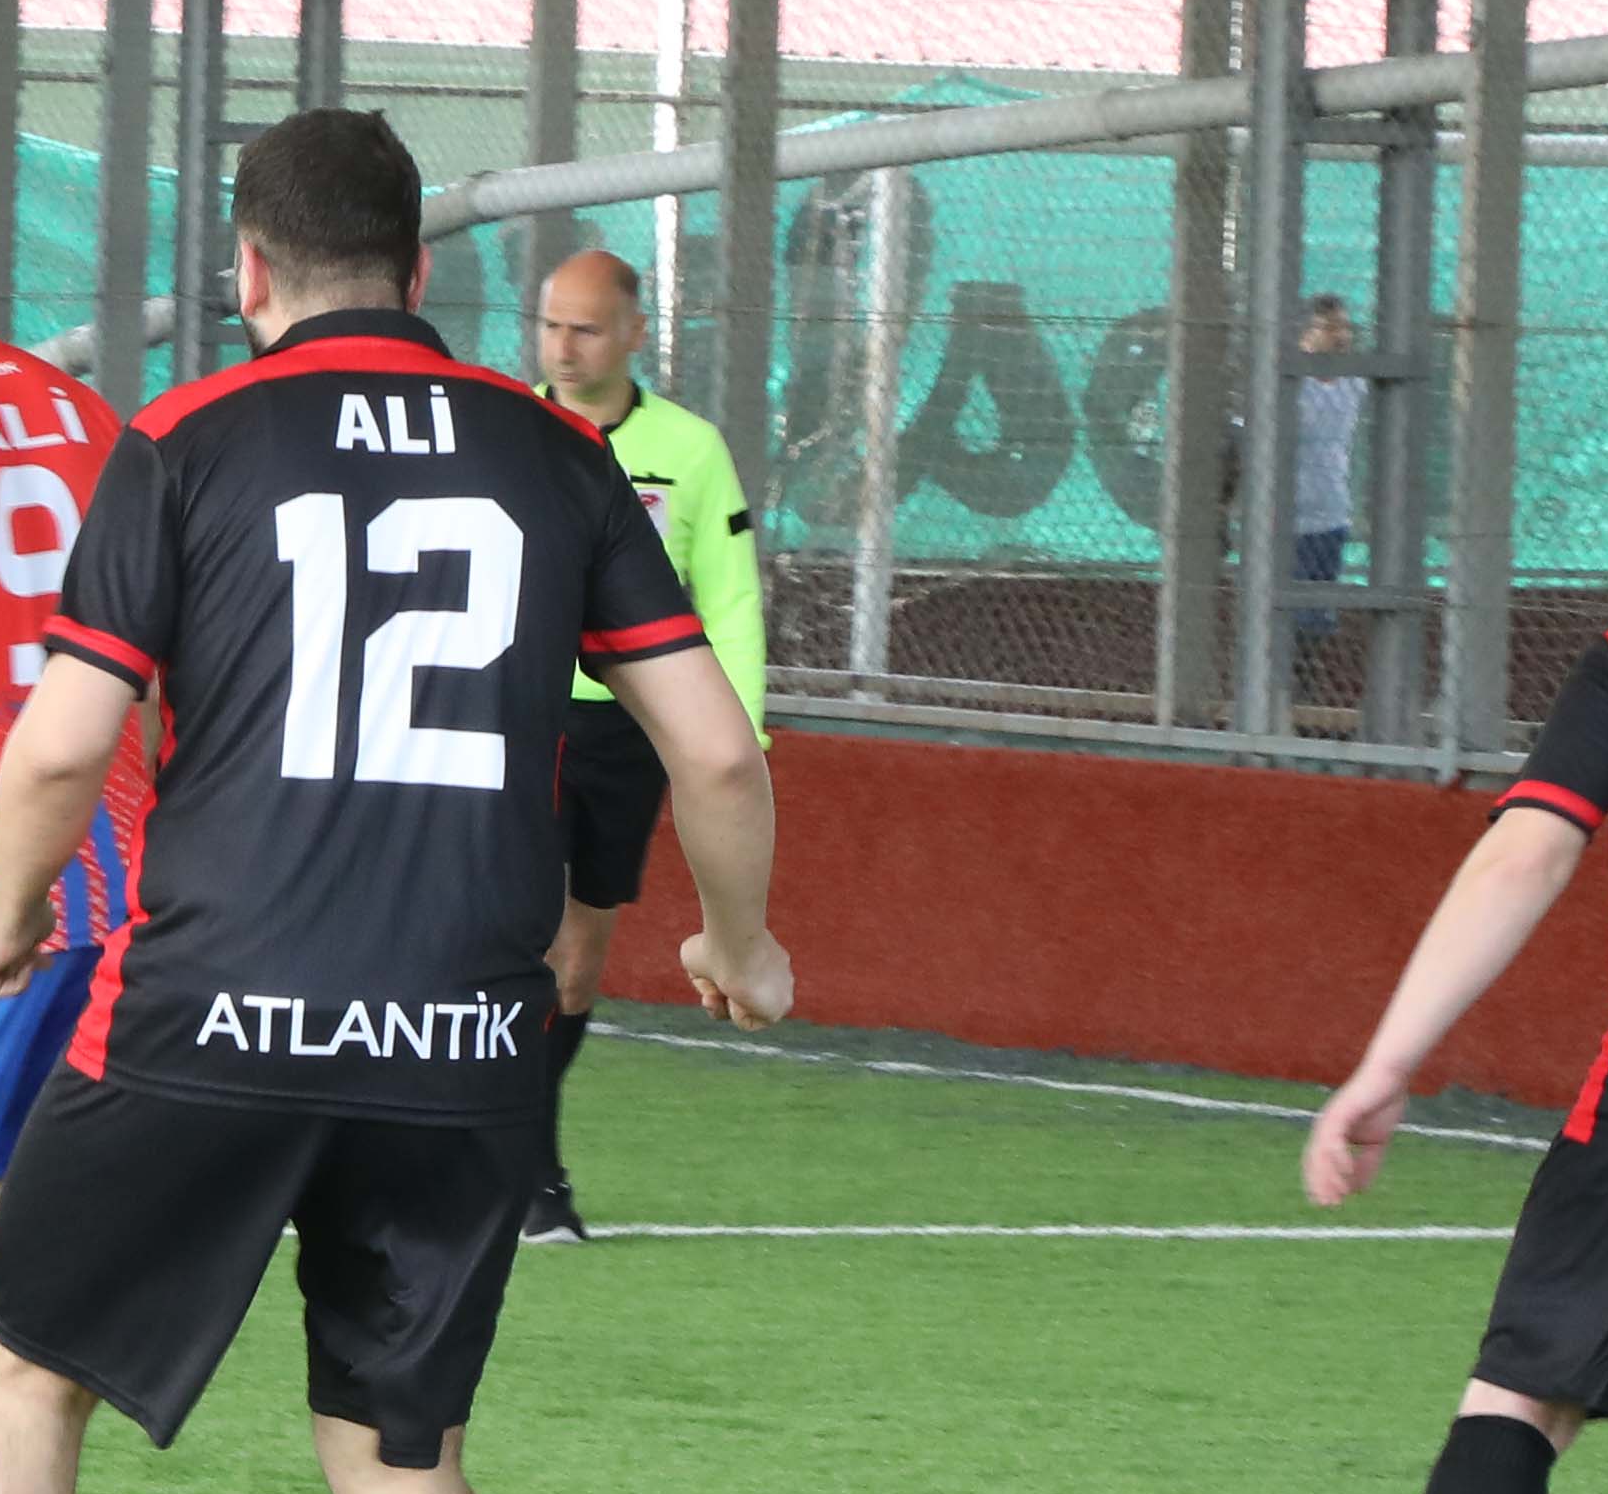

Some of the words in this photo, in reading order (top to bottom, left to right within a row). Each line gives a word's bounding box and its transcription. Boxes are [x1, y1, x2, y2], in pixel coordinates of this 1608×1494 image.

[335, 384, 458, 455] ALİ
[274, 492, 525, 790] 12
[195, 988, 523, 1059] ATLANTİK
